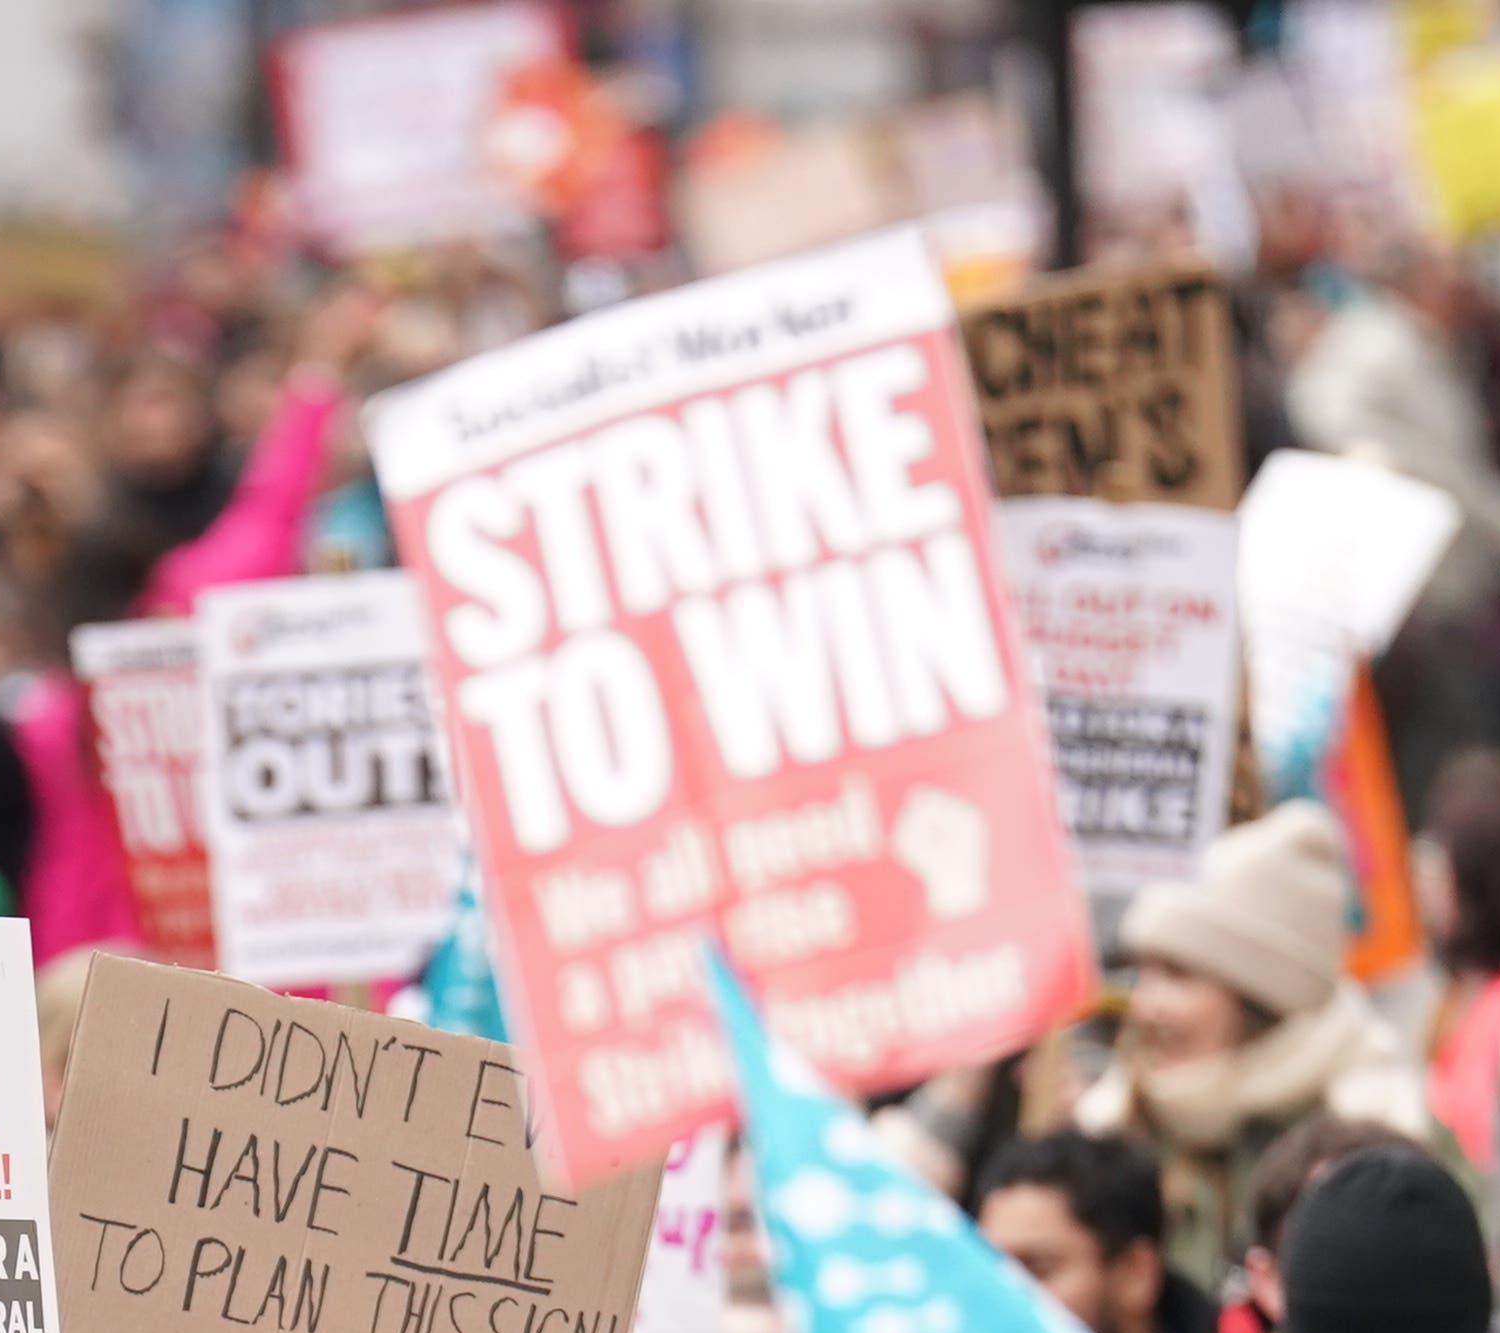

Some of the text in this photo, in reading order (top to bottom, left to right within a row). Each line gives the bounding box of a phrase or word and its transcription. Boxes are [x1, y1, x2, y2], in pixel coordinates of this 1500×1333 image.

[424, 340, 963, 672] STRIKE
[456, 622, 676, 855] TO
[668, 527, 1006, 782] WIN
[150, 997, 172, 1077] I
[208, 1007, 442, 1124] DIDN'T
[12, 1233, 40, 1281] A
[79, 1212, 166, 1295] TO
[167, 1117, 359, 1236] HAVE
[391, 1161, 579, 1284] TIME
